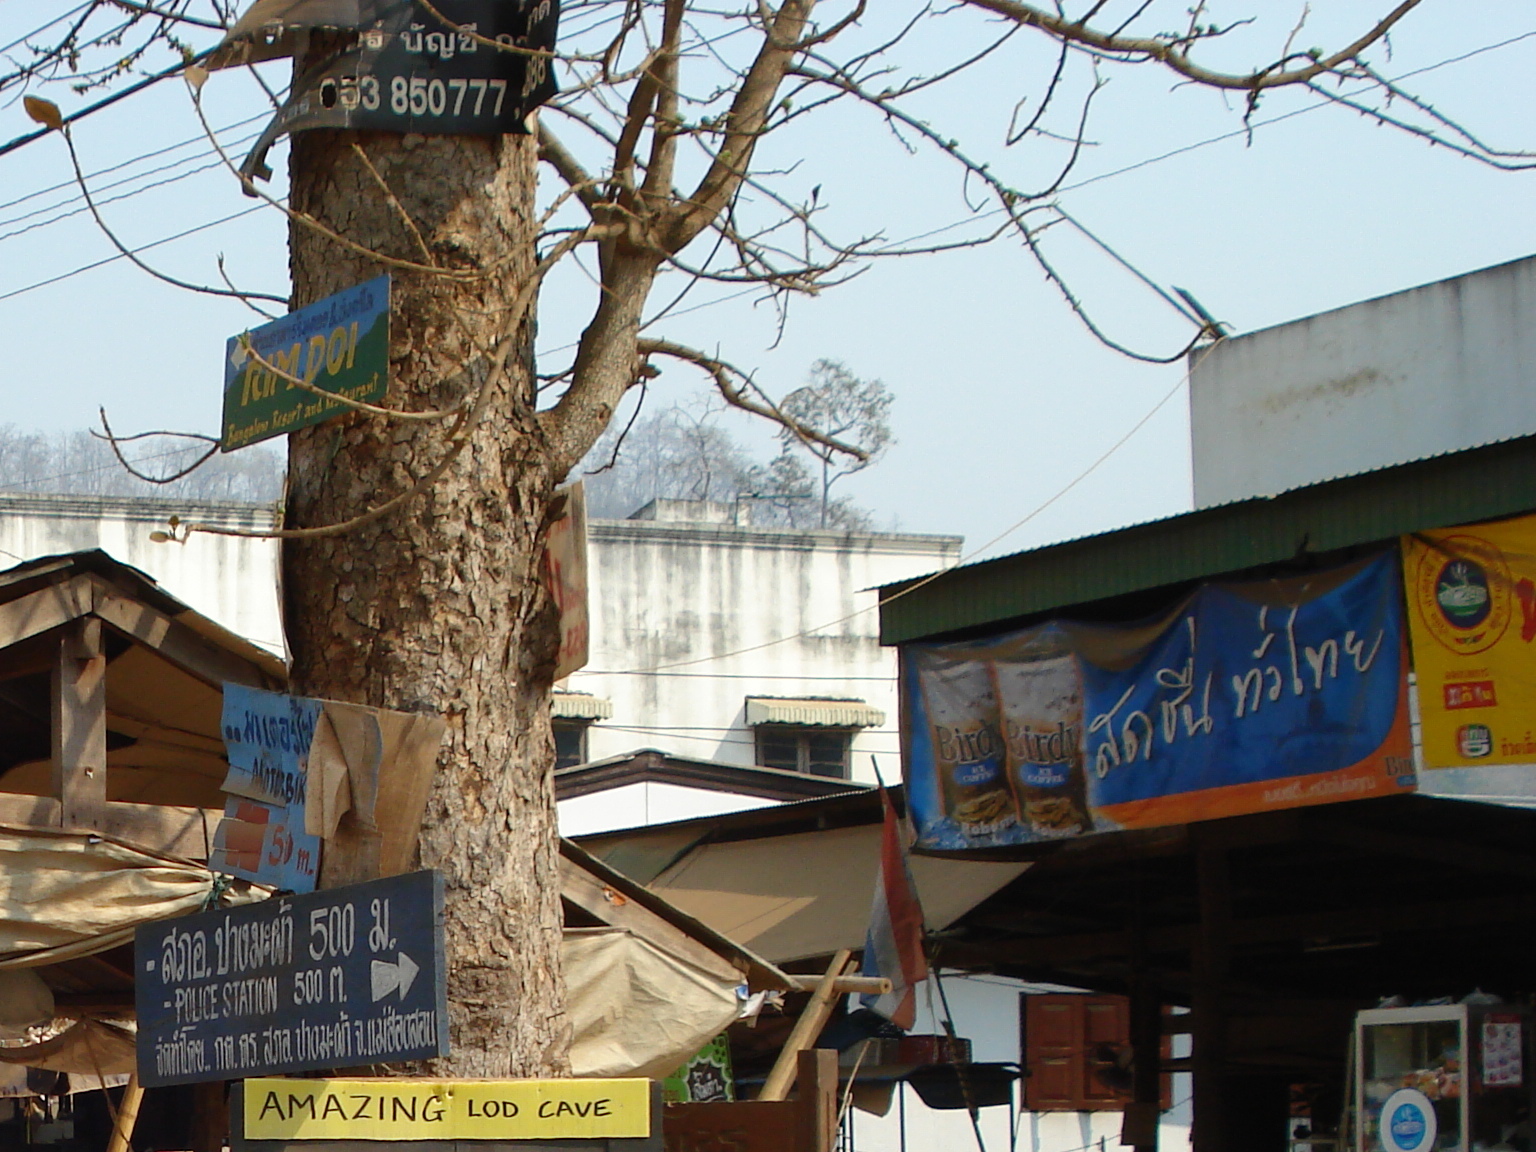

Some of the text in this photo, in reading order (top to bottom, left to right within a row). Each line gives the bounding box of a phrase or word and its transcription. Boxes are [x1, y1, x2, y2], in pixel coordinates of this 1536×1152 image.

[391, 75, 509, 118] 850777
[304, 321, 359, 385] DOI
[309, 902, 355, 961] 500
[369, 898, 398, 952] ม.
[175, 983, 219, 1025] POLICE
[222, 976, 279, 1018] STATION
[293, 968, 323, 1006] 500
[259, 1091, 612, 1122] AMAZING LOD CAVE
